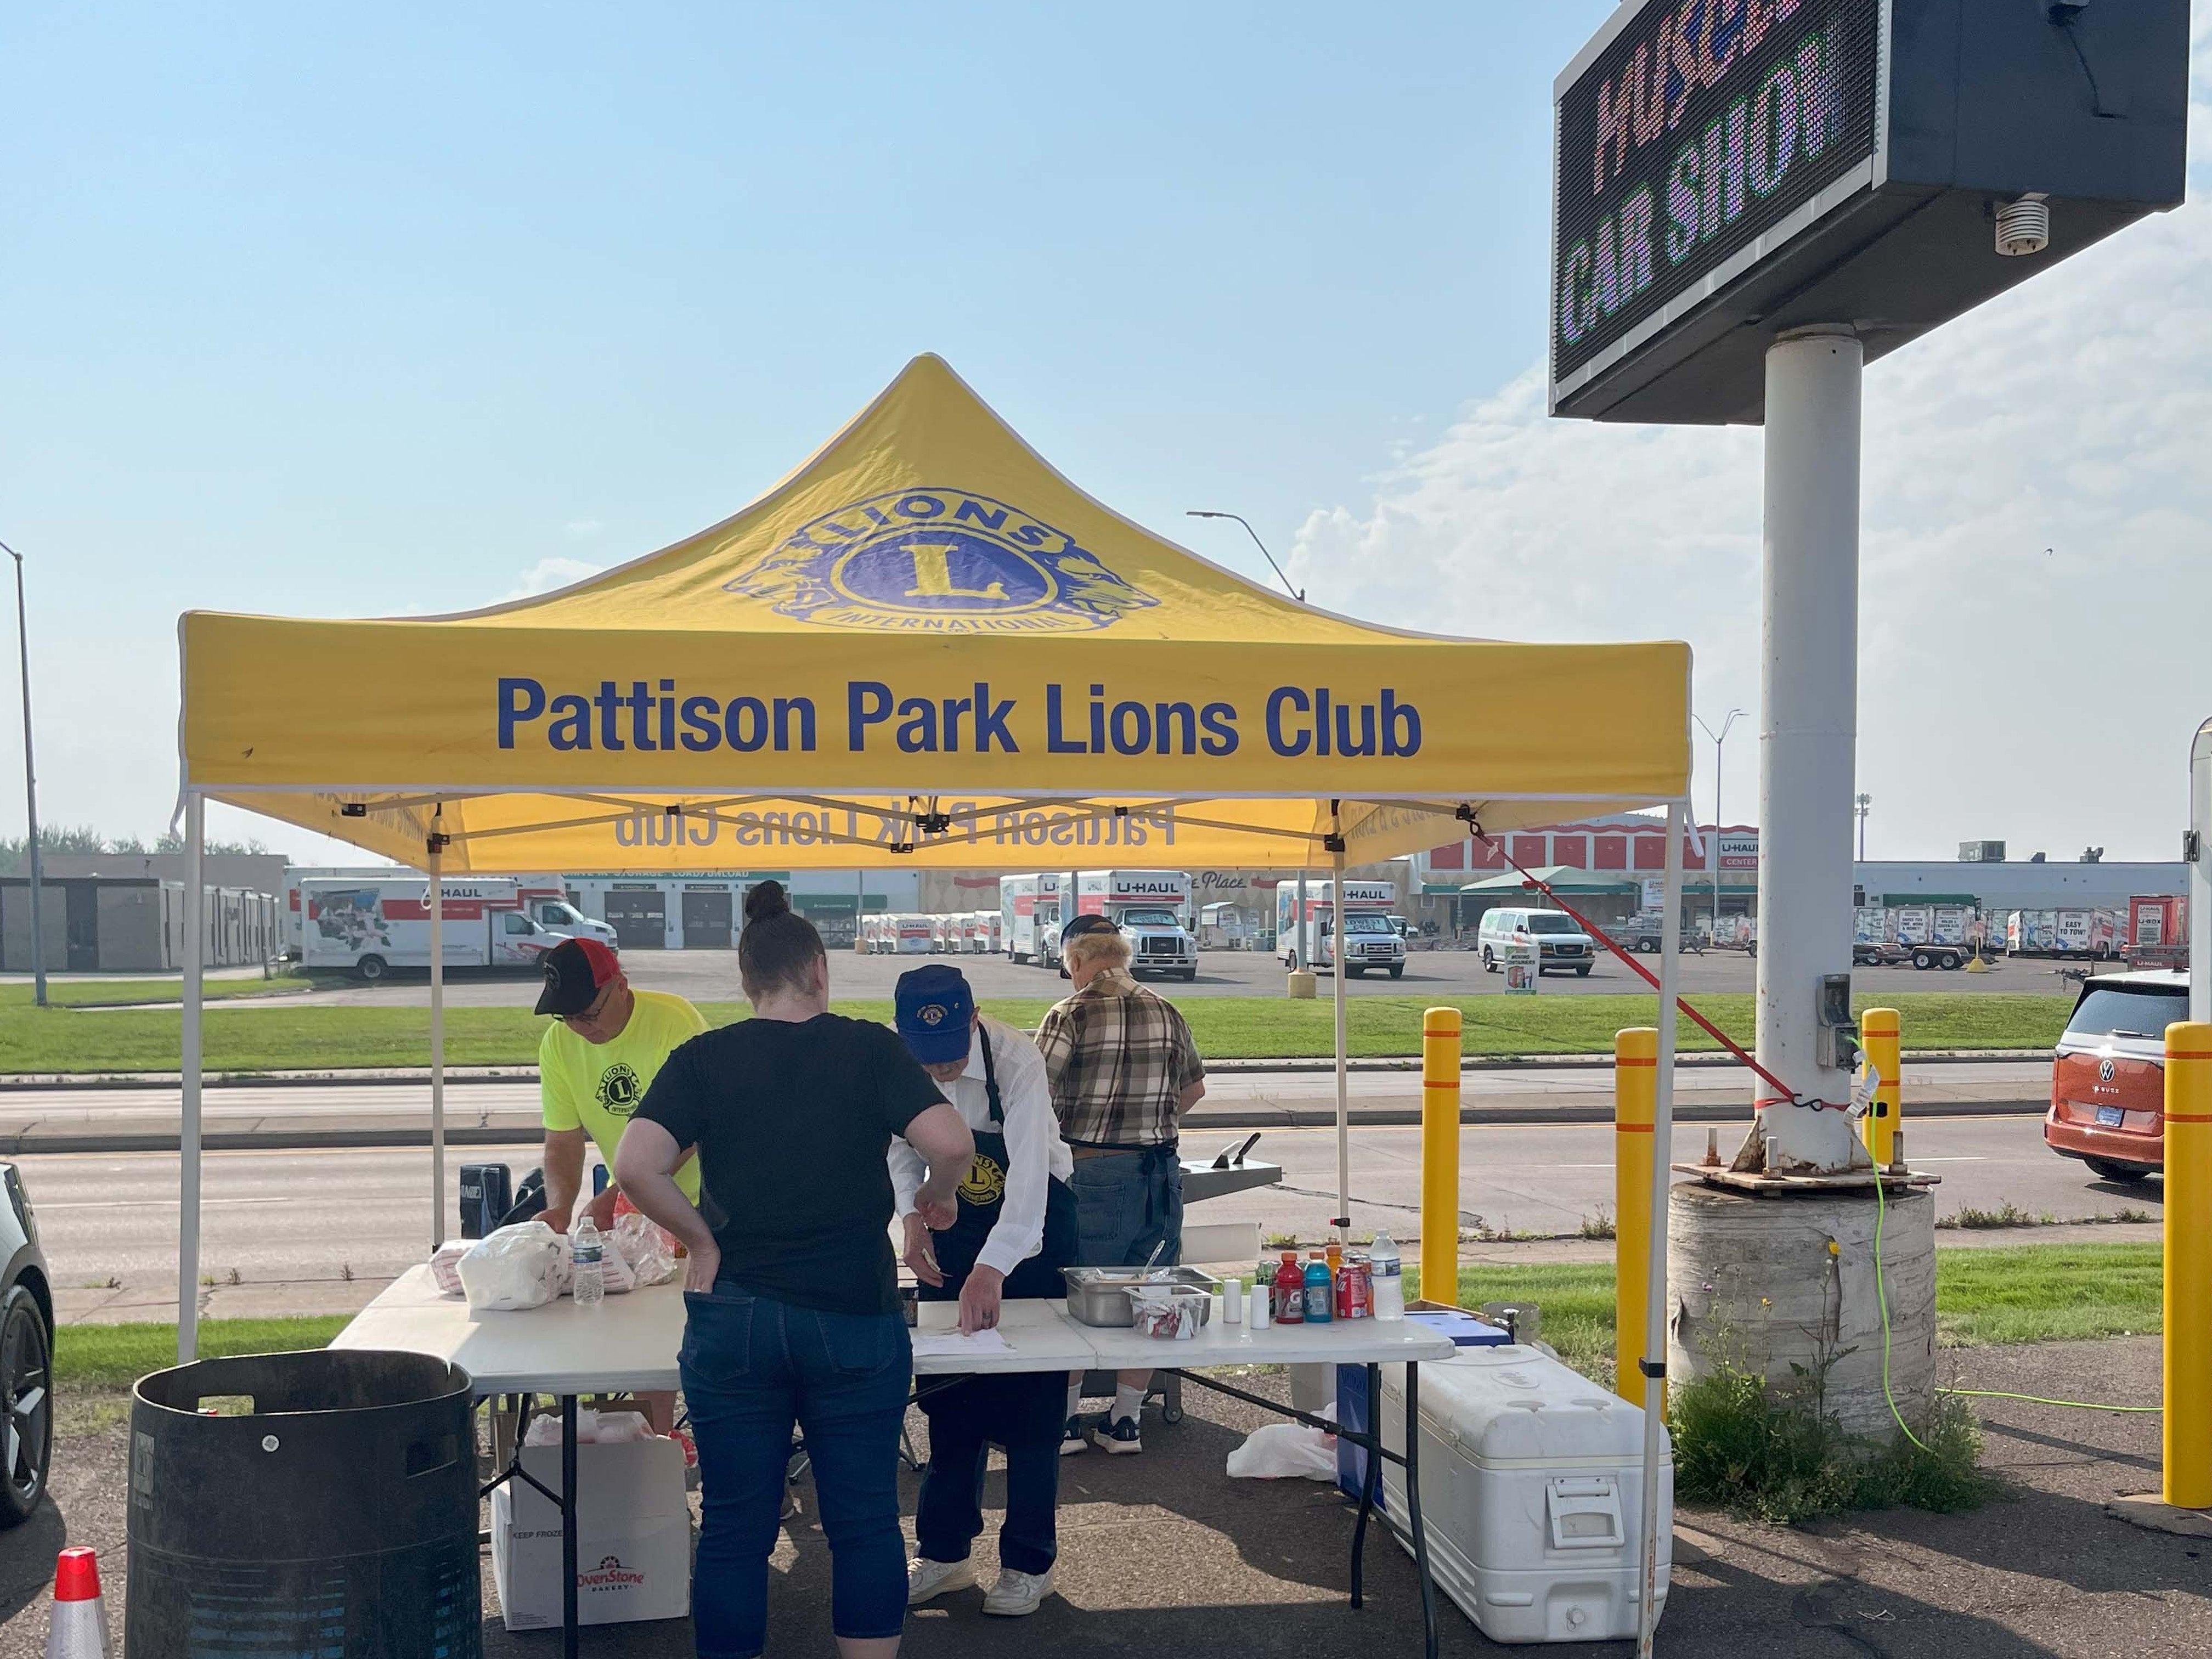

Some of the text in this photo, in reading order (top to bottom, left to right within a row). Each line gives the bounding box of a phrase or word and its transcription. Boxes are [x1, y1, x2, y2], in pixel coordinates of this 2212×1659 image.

[824, 495, 1053, 546] LIONS
[900, 543, 1011, 602] L
[827, 611, 1080, 630] INTERNATIONAL
[498, 677, 1422, 758] Pattison Park Lions Club
[1117, 883, 1179, 893] U-HAUL
[1201, 871, 1247, 889] Place
[423, 889, 482, 898] HAUL
[1342, 890, 1386, 899] -HAUL
[614, 1080, 630, 1099] L
[969, 1165, 986, 1184] L
[1290, 1291, 1300, 1304] G
[535, 1530, 563, 1538] FROZE
